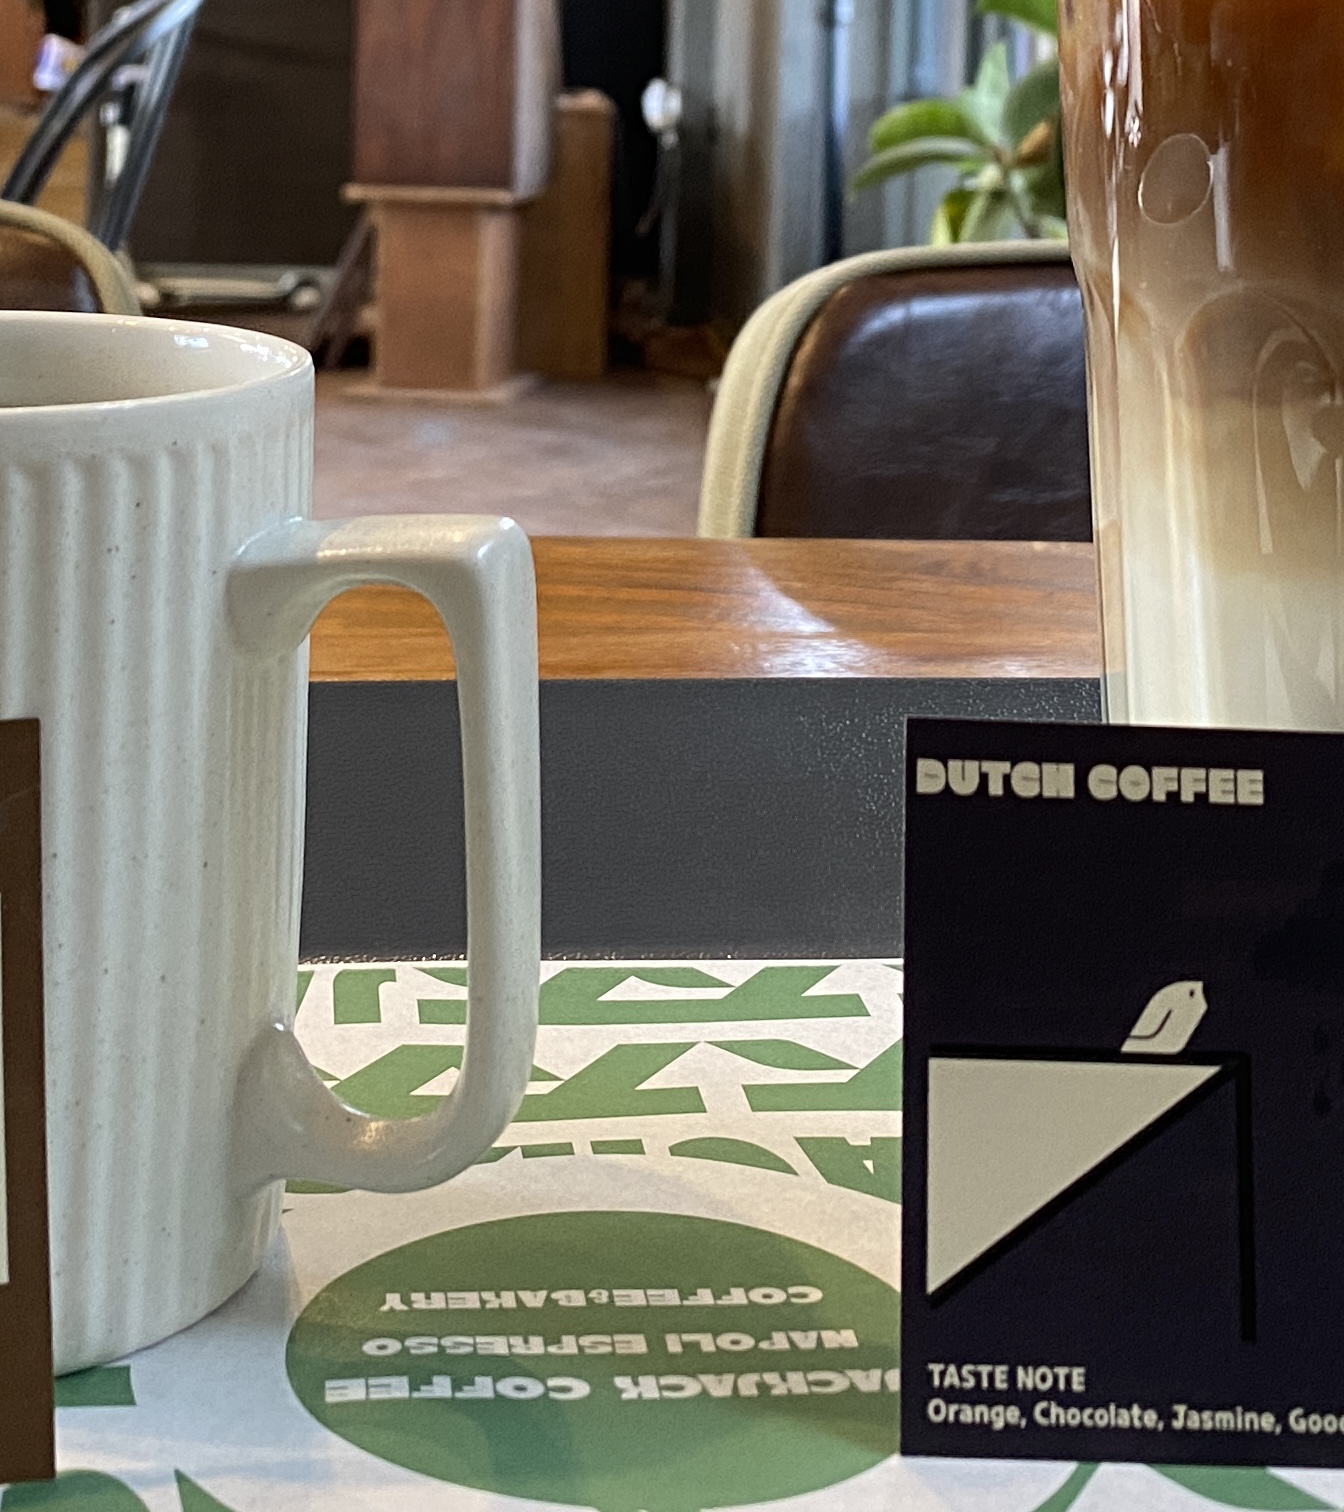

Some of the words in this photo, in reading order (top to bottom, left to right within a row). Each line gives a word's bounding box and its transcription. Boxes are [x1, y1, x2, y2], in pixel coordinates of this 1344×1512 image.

[915, 757, 1076, 800] DUTCH
[1087, 763, 1265, 806] COFFEE
[379, 1285, 824, 1313] COFFEE&BAKERY
[360, 1334, 649, 1357] ESPRESSO
[664, 1328, 859, 1354] NAPOLI
[324, 1374, 591, 1405] COFFEE
[927, 1362, 1010, 1392] TASTE
[1016, 1365, 1086, 1394] NOTE
[926, 1396, 1028, 1432] Orange,
[1032, 1399, 1164, 1433] Chocolate,
[1170, 1402, 1283, 1437] Jasmine,
